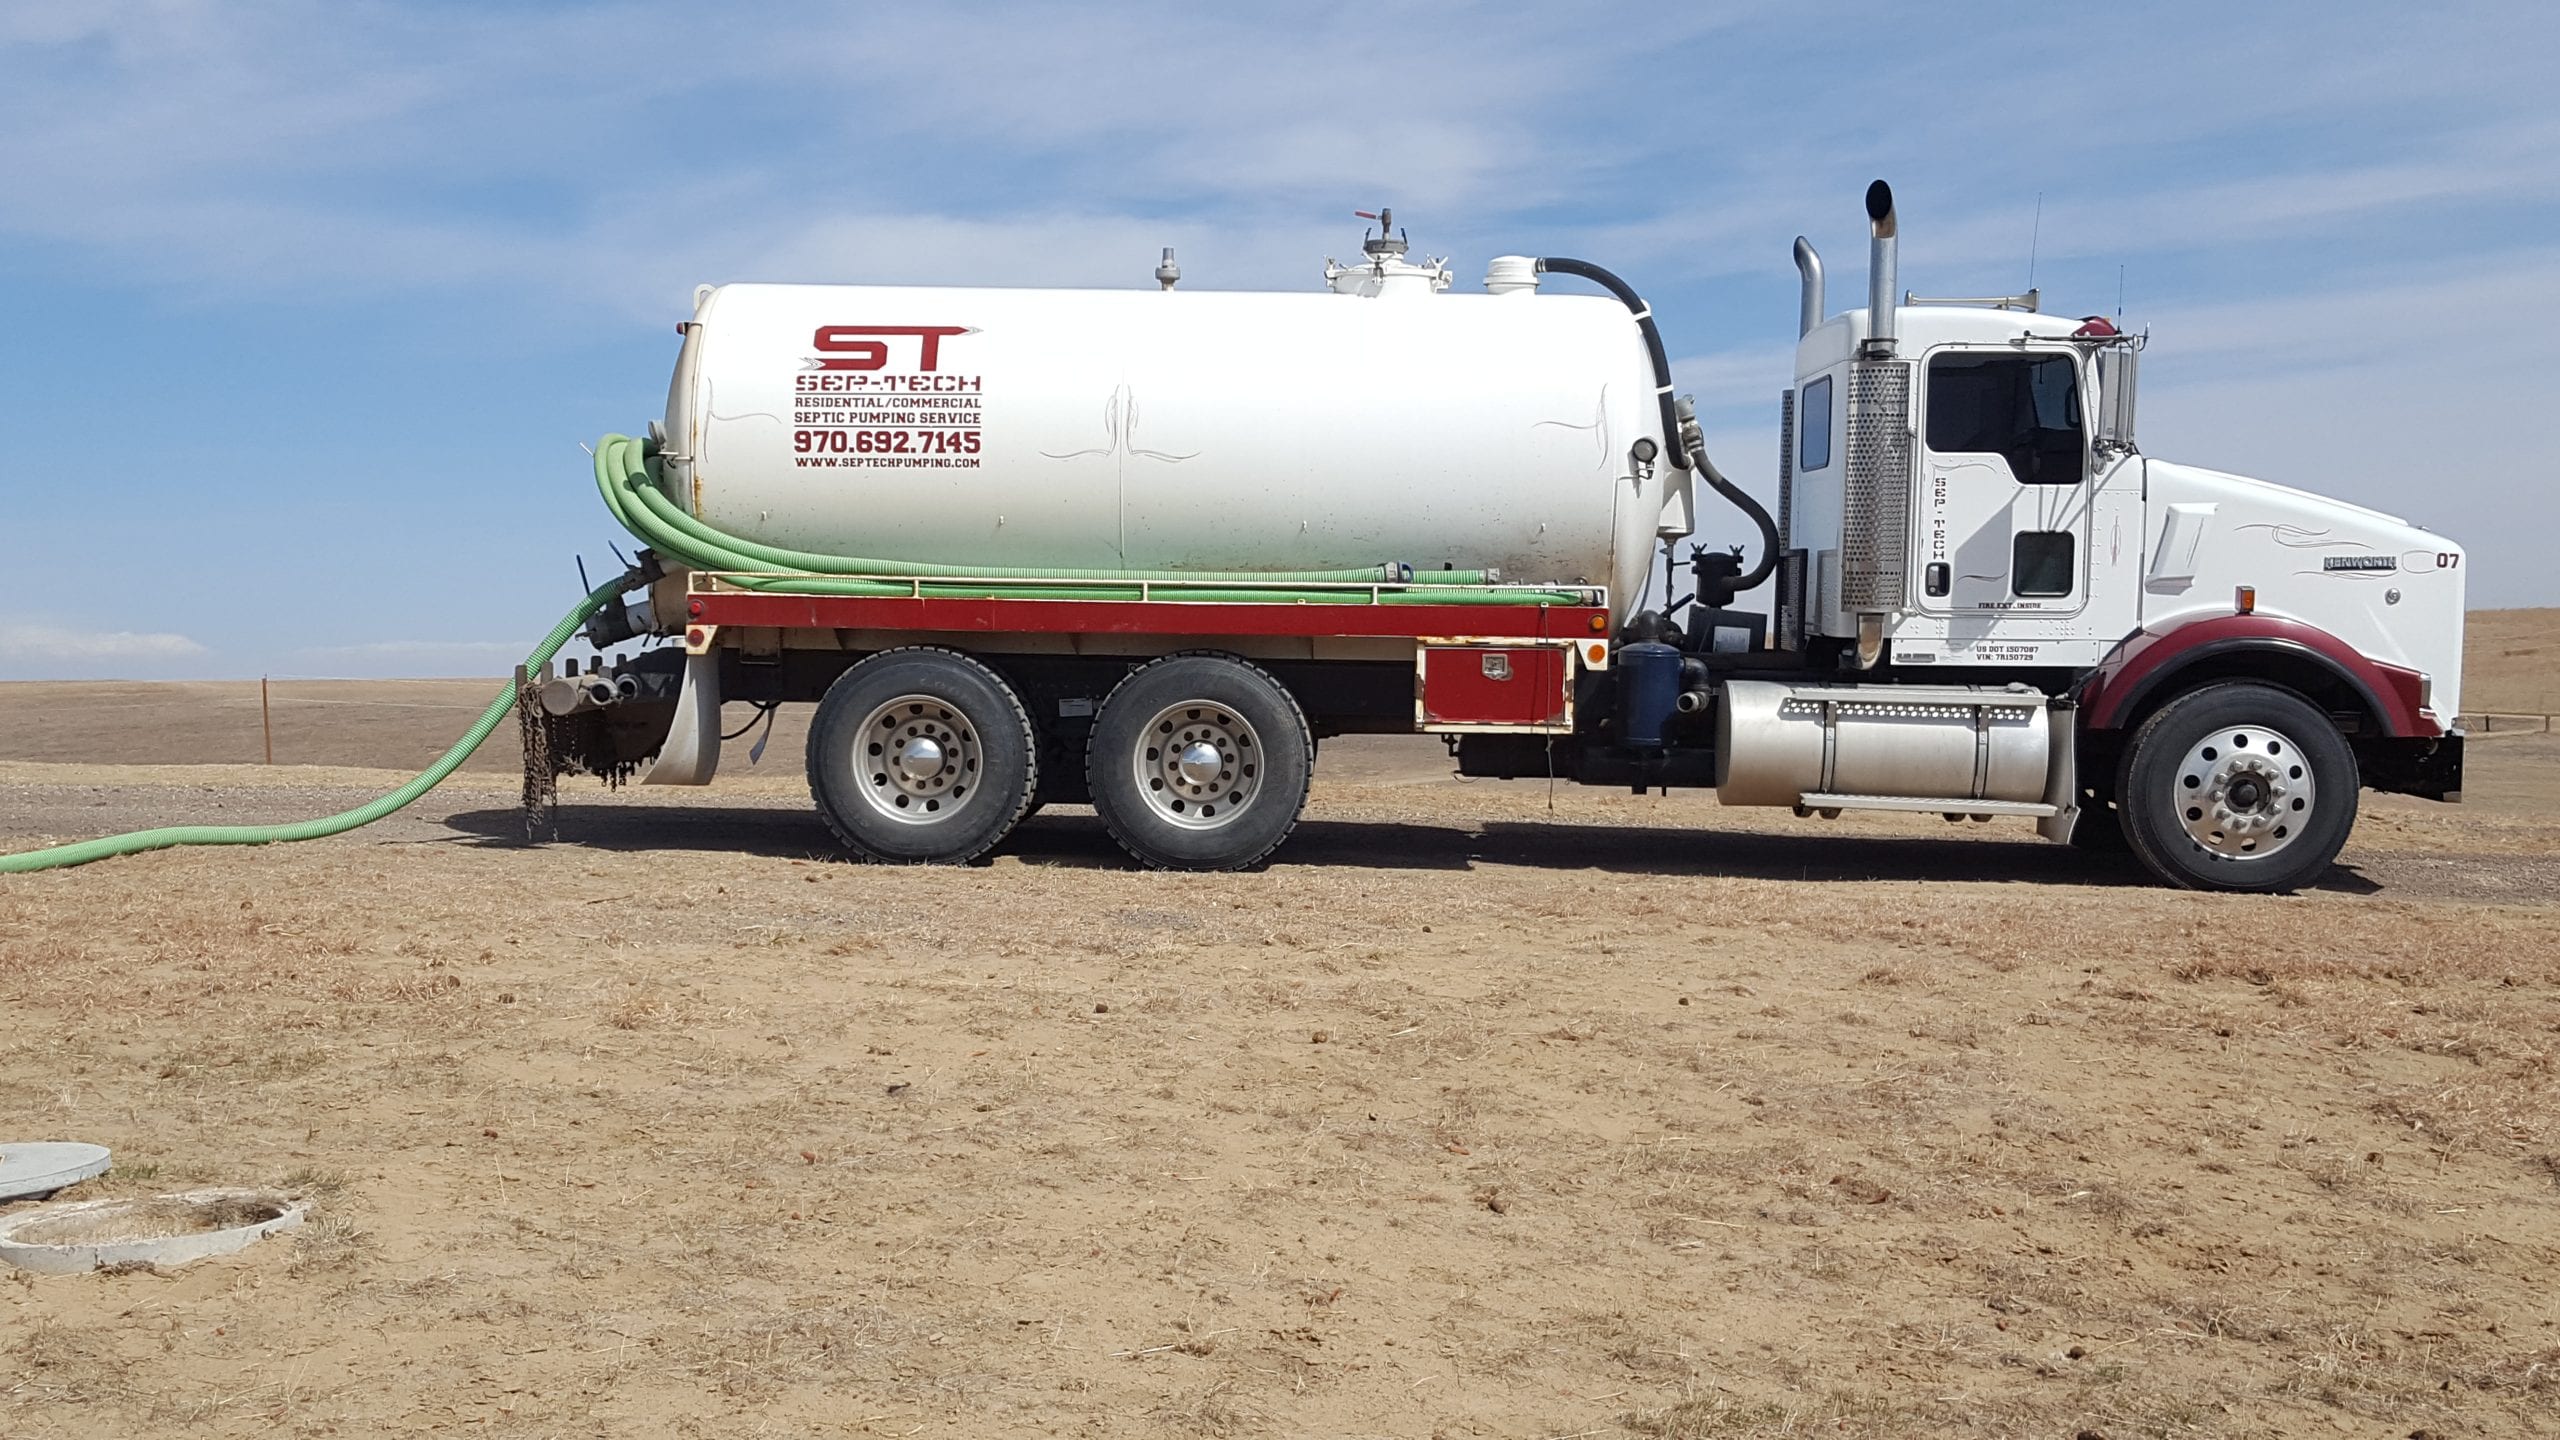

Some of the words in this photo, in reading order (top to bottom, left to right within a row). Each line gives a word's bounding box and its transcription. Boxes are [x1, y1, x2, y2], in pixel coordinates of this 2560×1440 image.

[813, 325, 970, 372] ST
[795, 375, 982, 392] SEP-TECH
[794, 397, 982, 409] RESIDENTIAL/COMMERCIAL
[794, 412, 845, 424] SEPTIC
[849, 412, 916, 424] PUMPING
[919, 412, 981, 425] SERVICE
[794, 430, 981, 454] 970.692.7145
[794, 457, 981, 468] WWW.SEPTECHPUMPING.COM
[2323, 556, 2397, 571] KENWORTH
[2436, 552, 2460, 569] 07
[1976, 645, 1987, 653] US
[1988, 645, 2005, 653] DOT
[1976, 653, 1994, 661] VIN:
